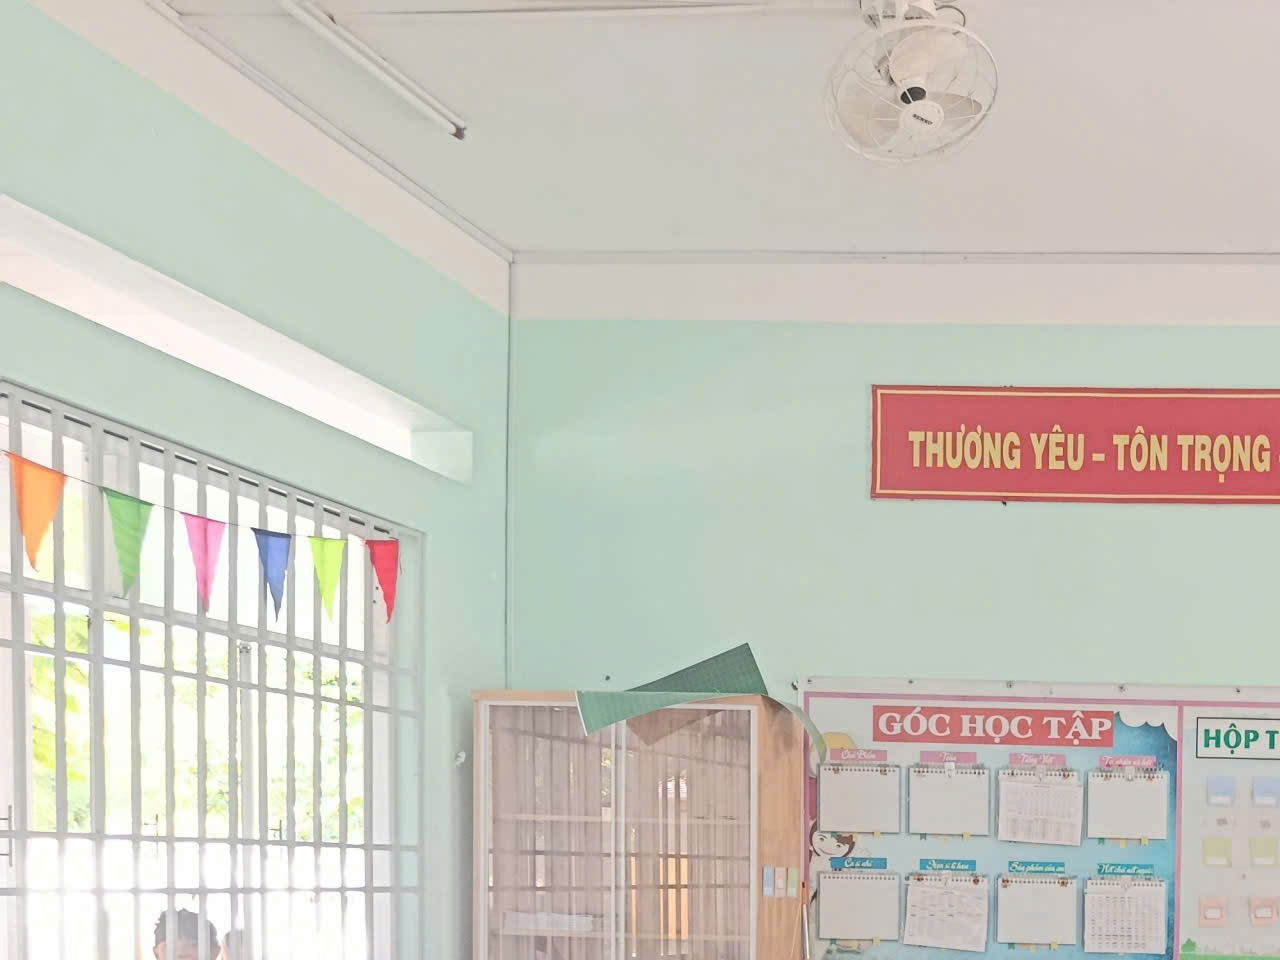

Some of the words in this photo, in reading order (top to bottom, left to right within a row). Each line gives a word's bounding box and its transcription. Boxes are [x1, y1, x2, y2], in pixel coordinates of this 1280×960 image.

[908, 424, 1021, 468] THƯƠNG
[1029, 425, 1085, 469] YÊU
[1113, 426, 1168, 470] TÔN
[1177, 434, 1271, 482] TRỌNG
[878, 707, 950, 736] GÓC
[960, 714, 1032, 743] HỌC
[1043, 711, 1112, 745] TẬP
[1203, 722, 1259, 755] HỘP
